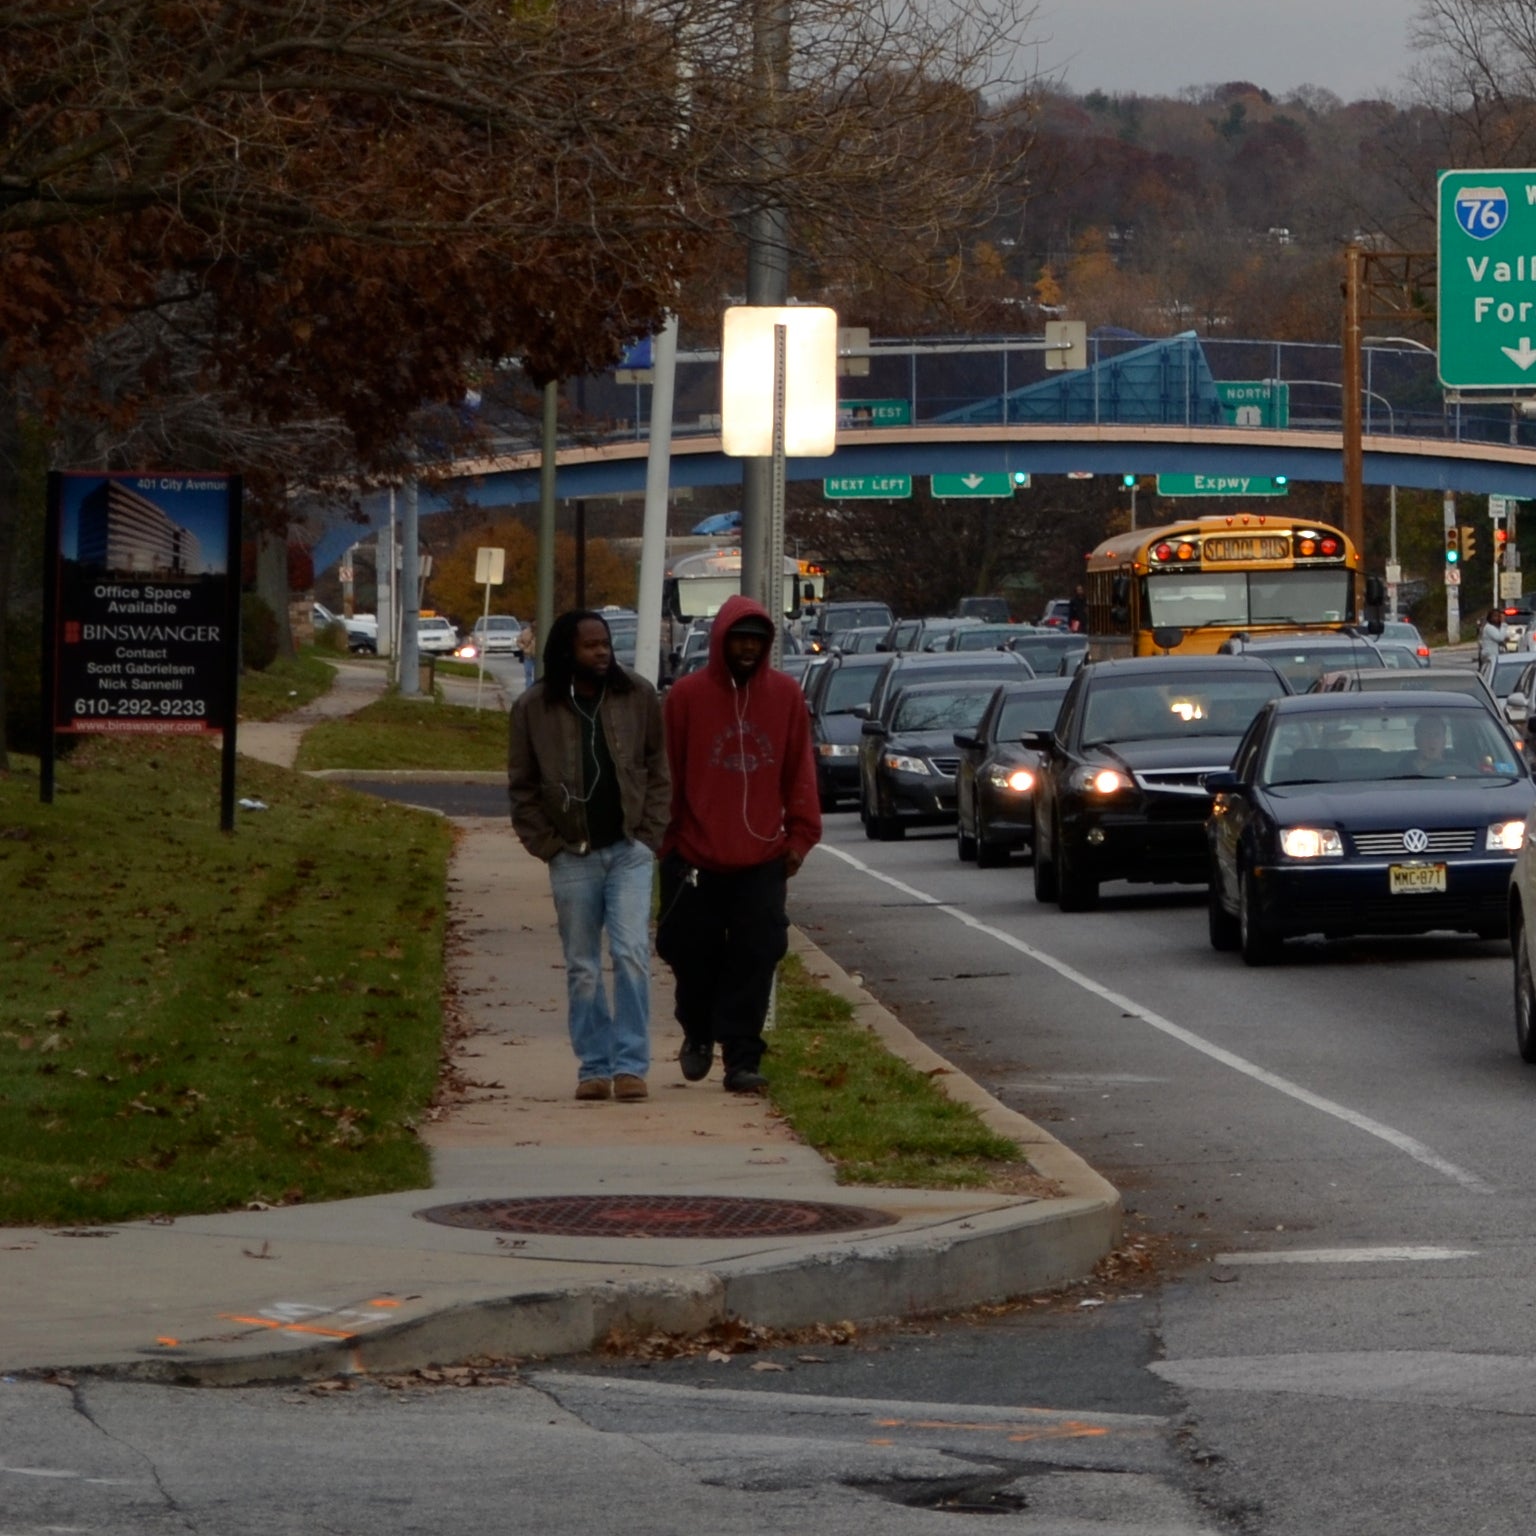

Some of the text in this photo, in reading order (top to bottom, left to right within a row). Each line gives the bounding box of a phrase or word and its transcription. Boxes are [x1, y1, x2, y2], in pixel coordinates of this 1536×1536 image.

[1461, 200, 1500, 230] 76
[1227, 388, 1271, 399] NORTH
[137, 478, 227, 491] 401 City Avenue
[831, 479, 904, 490] NEXT LEFT
[1194, 475, 1250, 493] Expwy
[1205, 537, 1287, 561] SCHOOL BUS
[94, 585, 191, 601] Office Space
[108, 601, 177, 614] Available
[83, 624, 220, 642] BINSWANGER
[116, 647, 167, 659] Contact
[87, 663, 195, 675] Scott Gabrielsen
[99, 678, 183, 690] Nick Sannelli
[74, 698, 206, 715] 610-292-9233
[76, 721, 202, 733] www.binswanger.com
